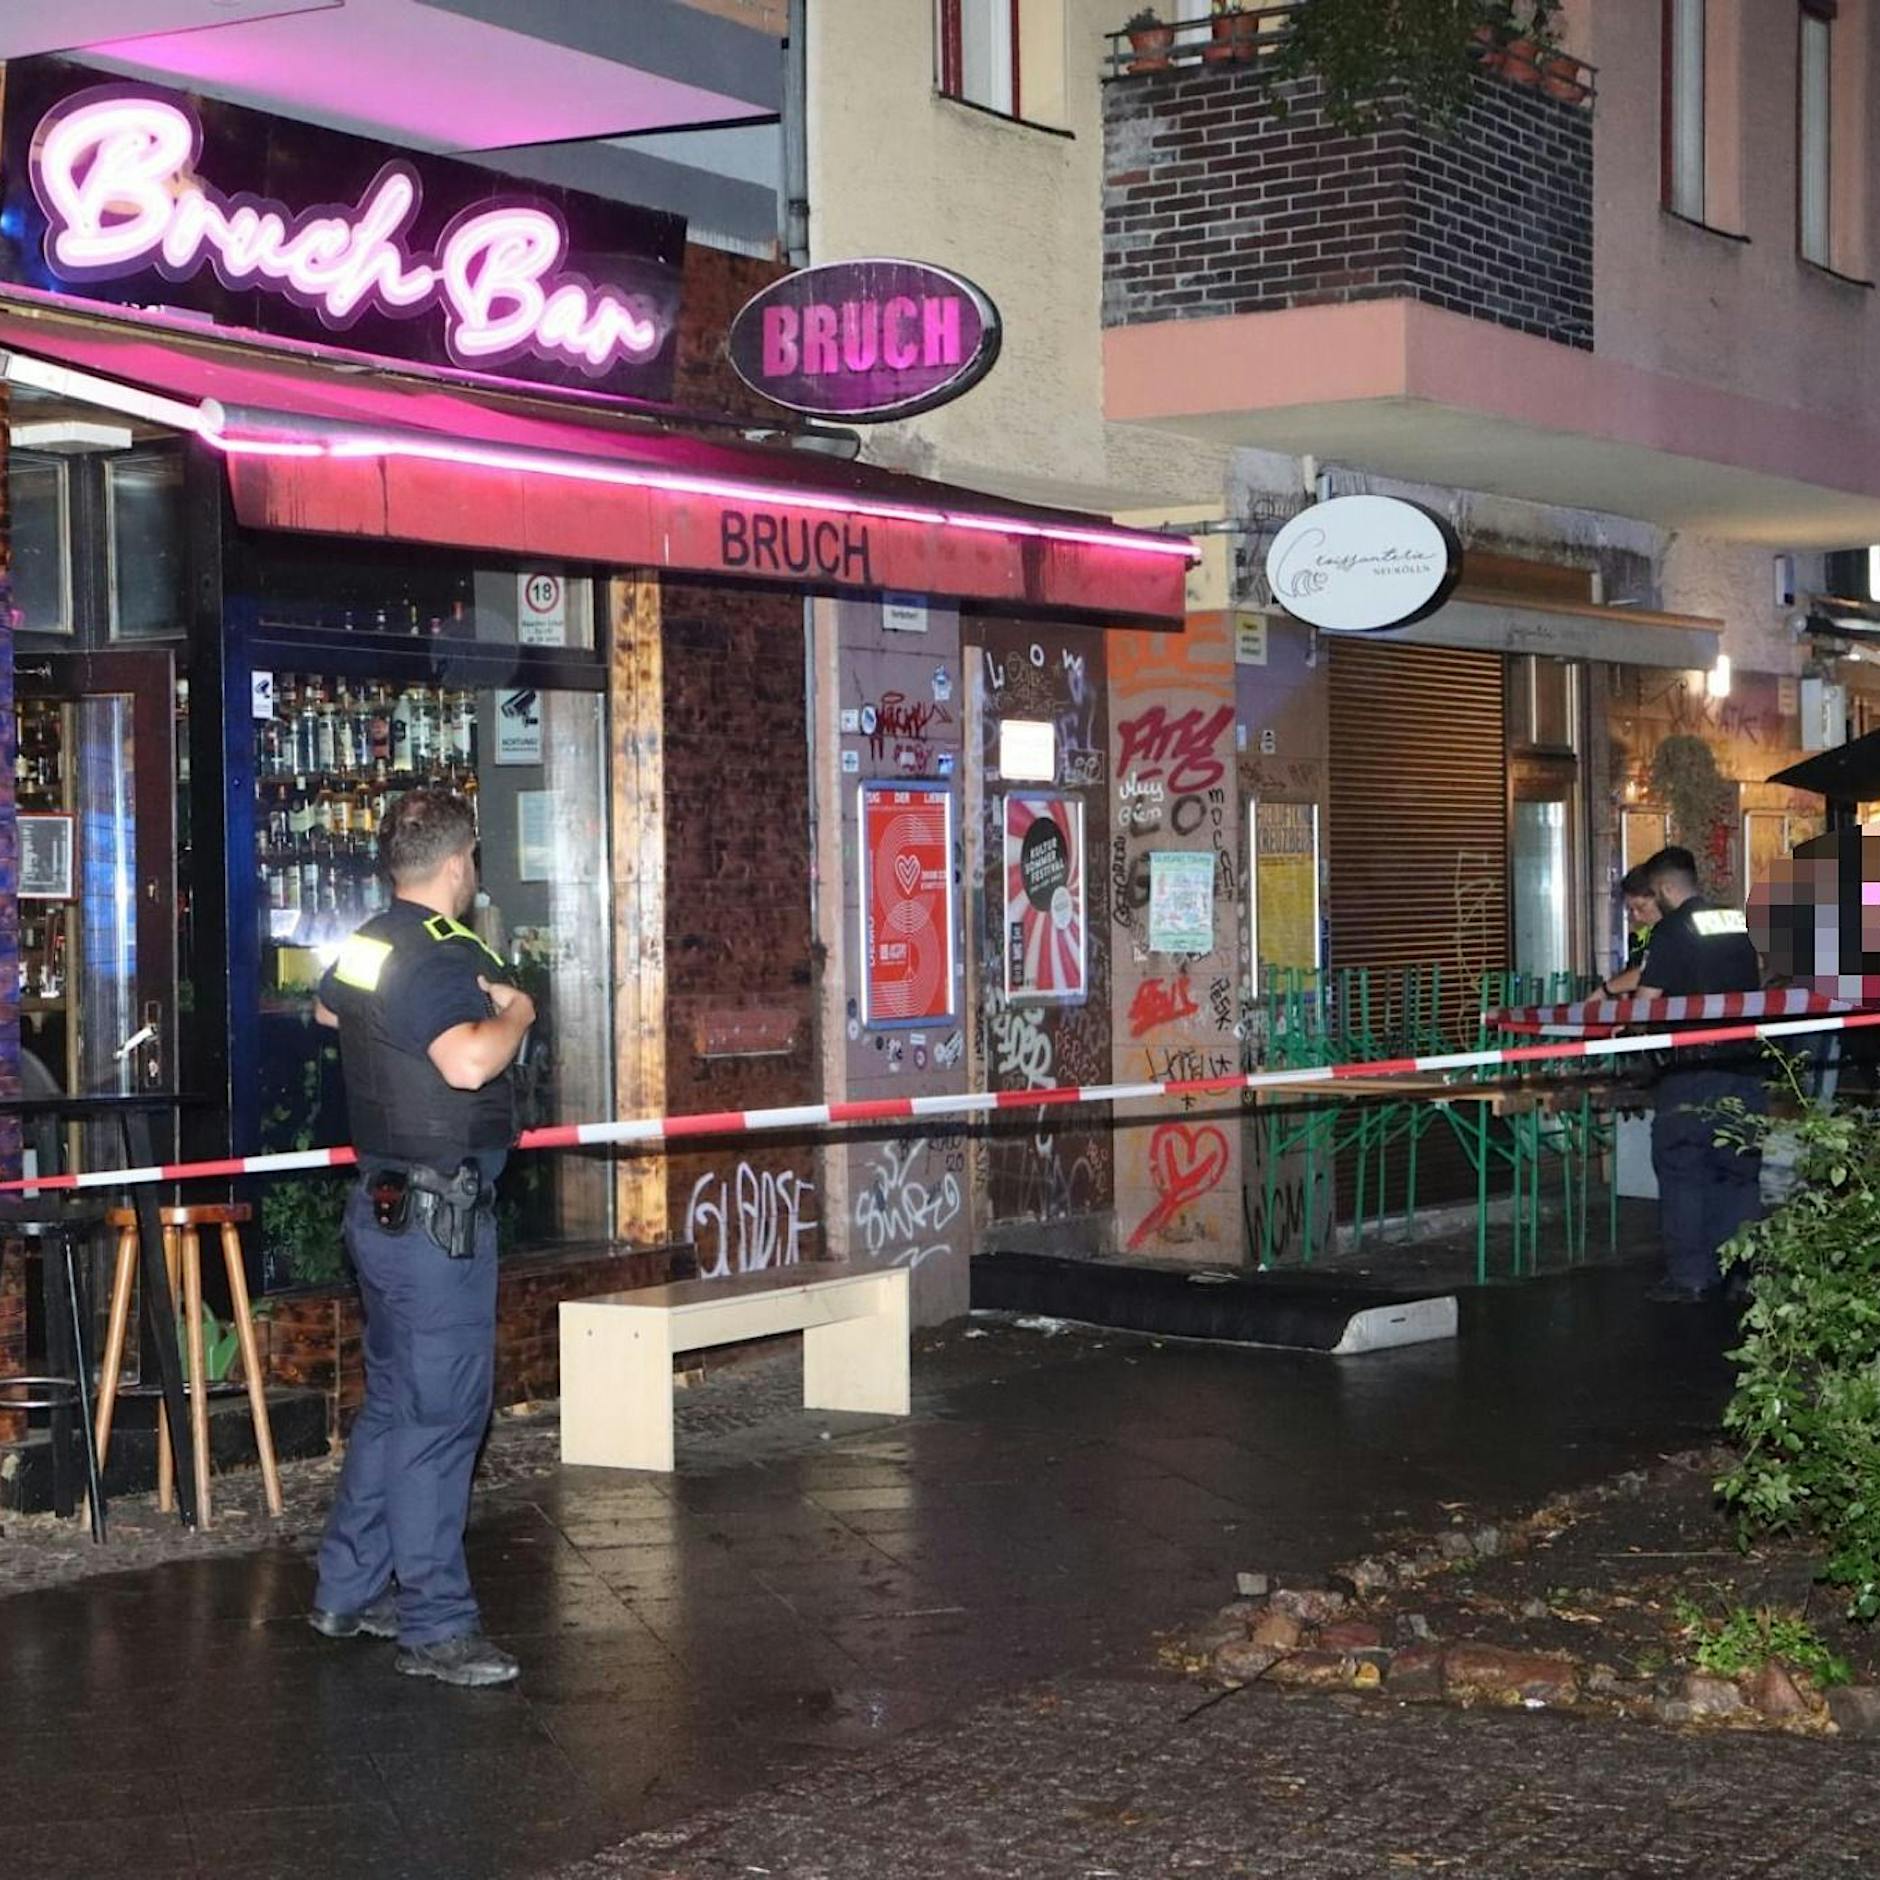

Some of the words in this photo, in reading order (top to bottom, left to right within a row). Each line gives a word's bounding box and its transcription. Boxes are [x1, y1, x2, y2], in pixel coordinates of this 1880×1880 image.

[36, 96, 438, 319] Bruch
[442, 206, 656, 366] Bar
[763, 296, 961, 377] BRUCH
[720, 510, 872, 584] BRUCH
[533, 582, 552, 602] 18
